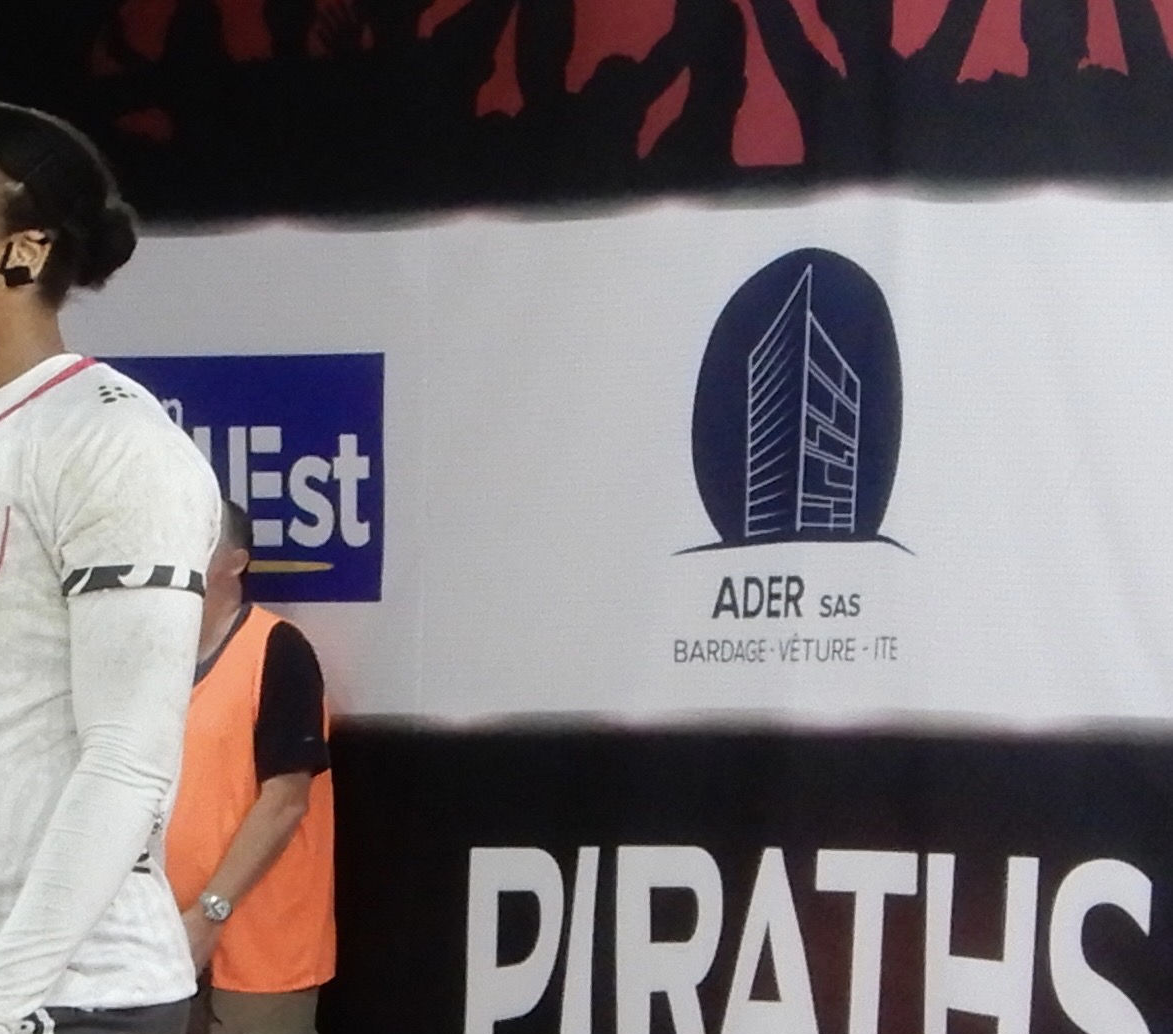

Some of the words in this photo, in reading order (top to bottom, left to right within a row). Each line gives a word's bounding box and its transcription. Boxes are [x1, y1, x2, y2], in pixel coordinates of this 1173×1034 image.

[711, 575, 805, 620] ADER
[819, 593, 861, 618] SAS
[673, 639, 767, 663] BARDAGE
[874, 636, 898, 661] ITE
